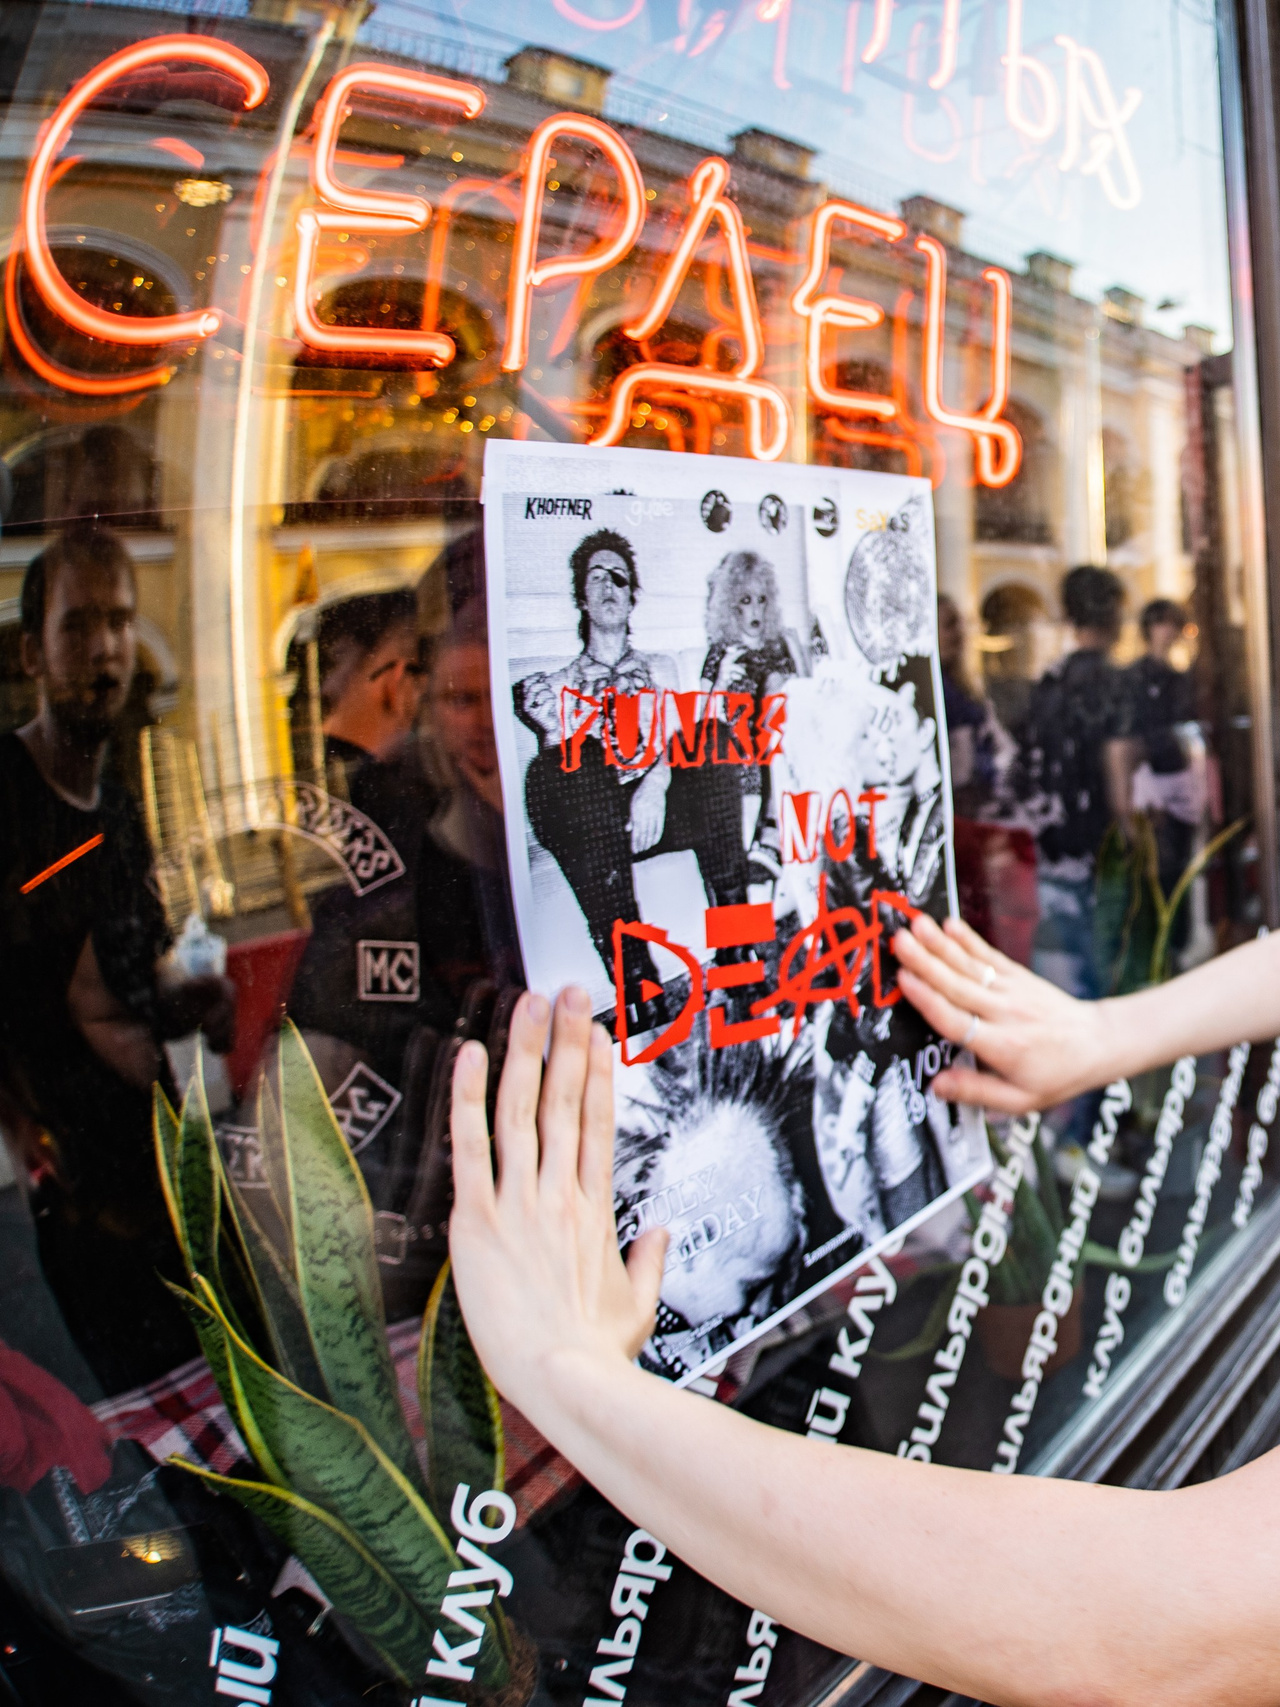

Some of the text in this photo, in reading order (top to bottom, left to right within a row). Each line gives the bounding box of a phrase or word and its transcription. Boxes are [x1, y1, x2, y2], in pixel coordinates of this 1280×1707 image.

[22, 33, 1024, 490] СЕРДЕЦ
[525, 497, 593, 521] KHOFFNER
[560, 685, 787, 773] PUNKS
[780, 787, 888, 863] NOT
[365, 950, 414, 992] MC
[627, 1162, 718, 1241] JULY
[664, 1183, 767, 1275] RIDAY
[990, 1077, 1133, 1475] ильярдный клу
[424, 1481, 518, 1682] клуб
